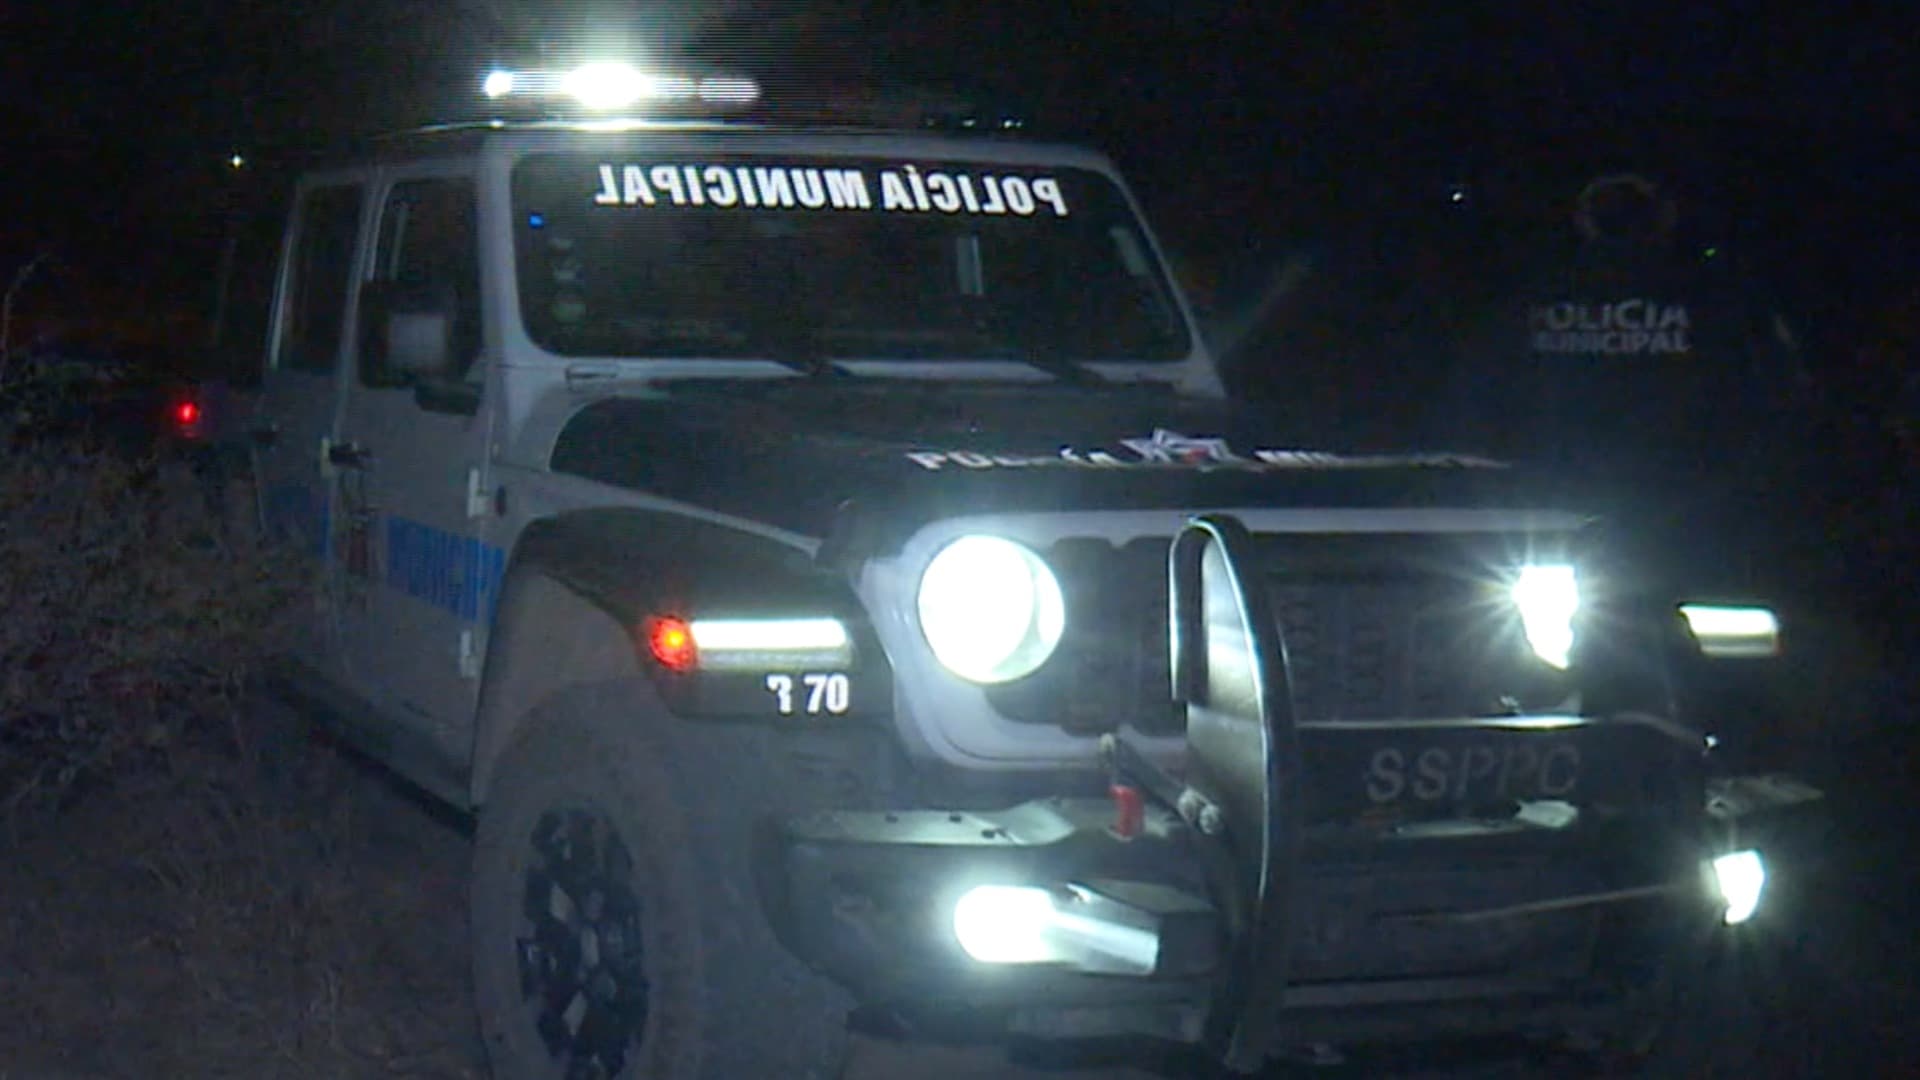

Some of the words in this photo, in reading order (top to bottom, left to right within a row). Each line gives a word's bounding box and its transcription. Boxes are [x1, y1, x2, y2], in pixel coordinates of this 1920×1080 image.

[1531, 298, 1691, 330] OLICIA
[803, 673, 849, 714] 70
[1366, 745, 1581, 802] SSPPC
